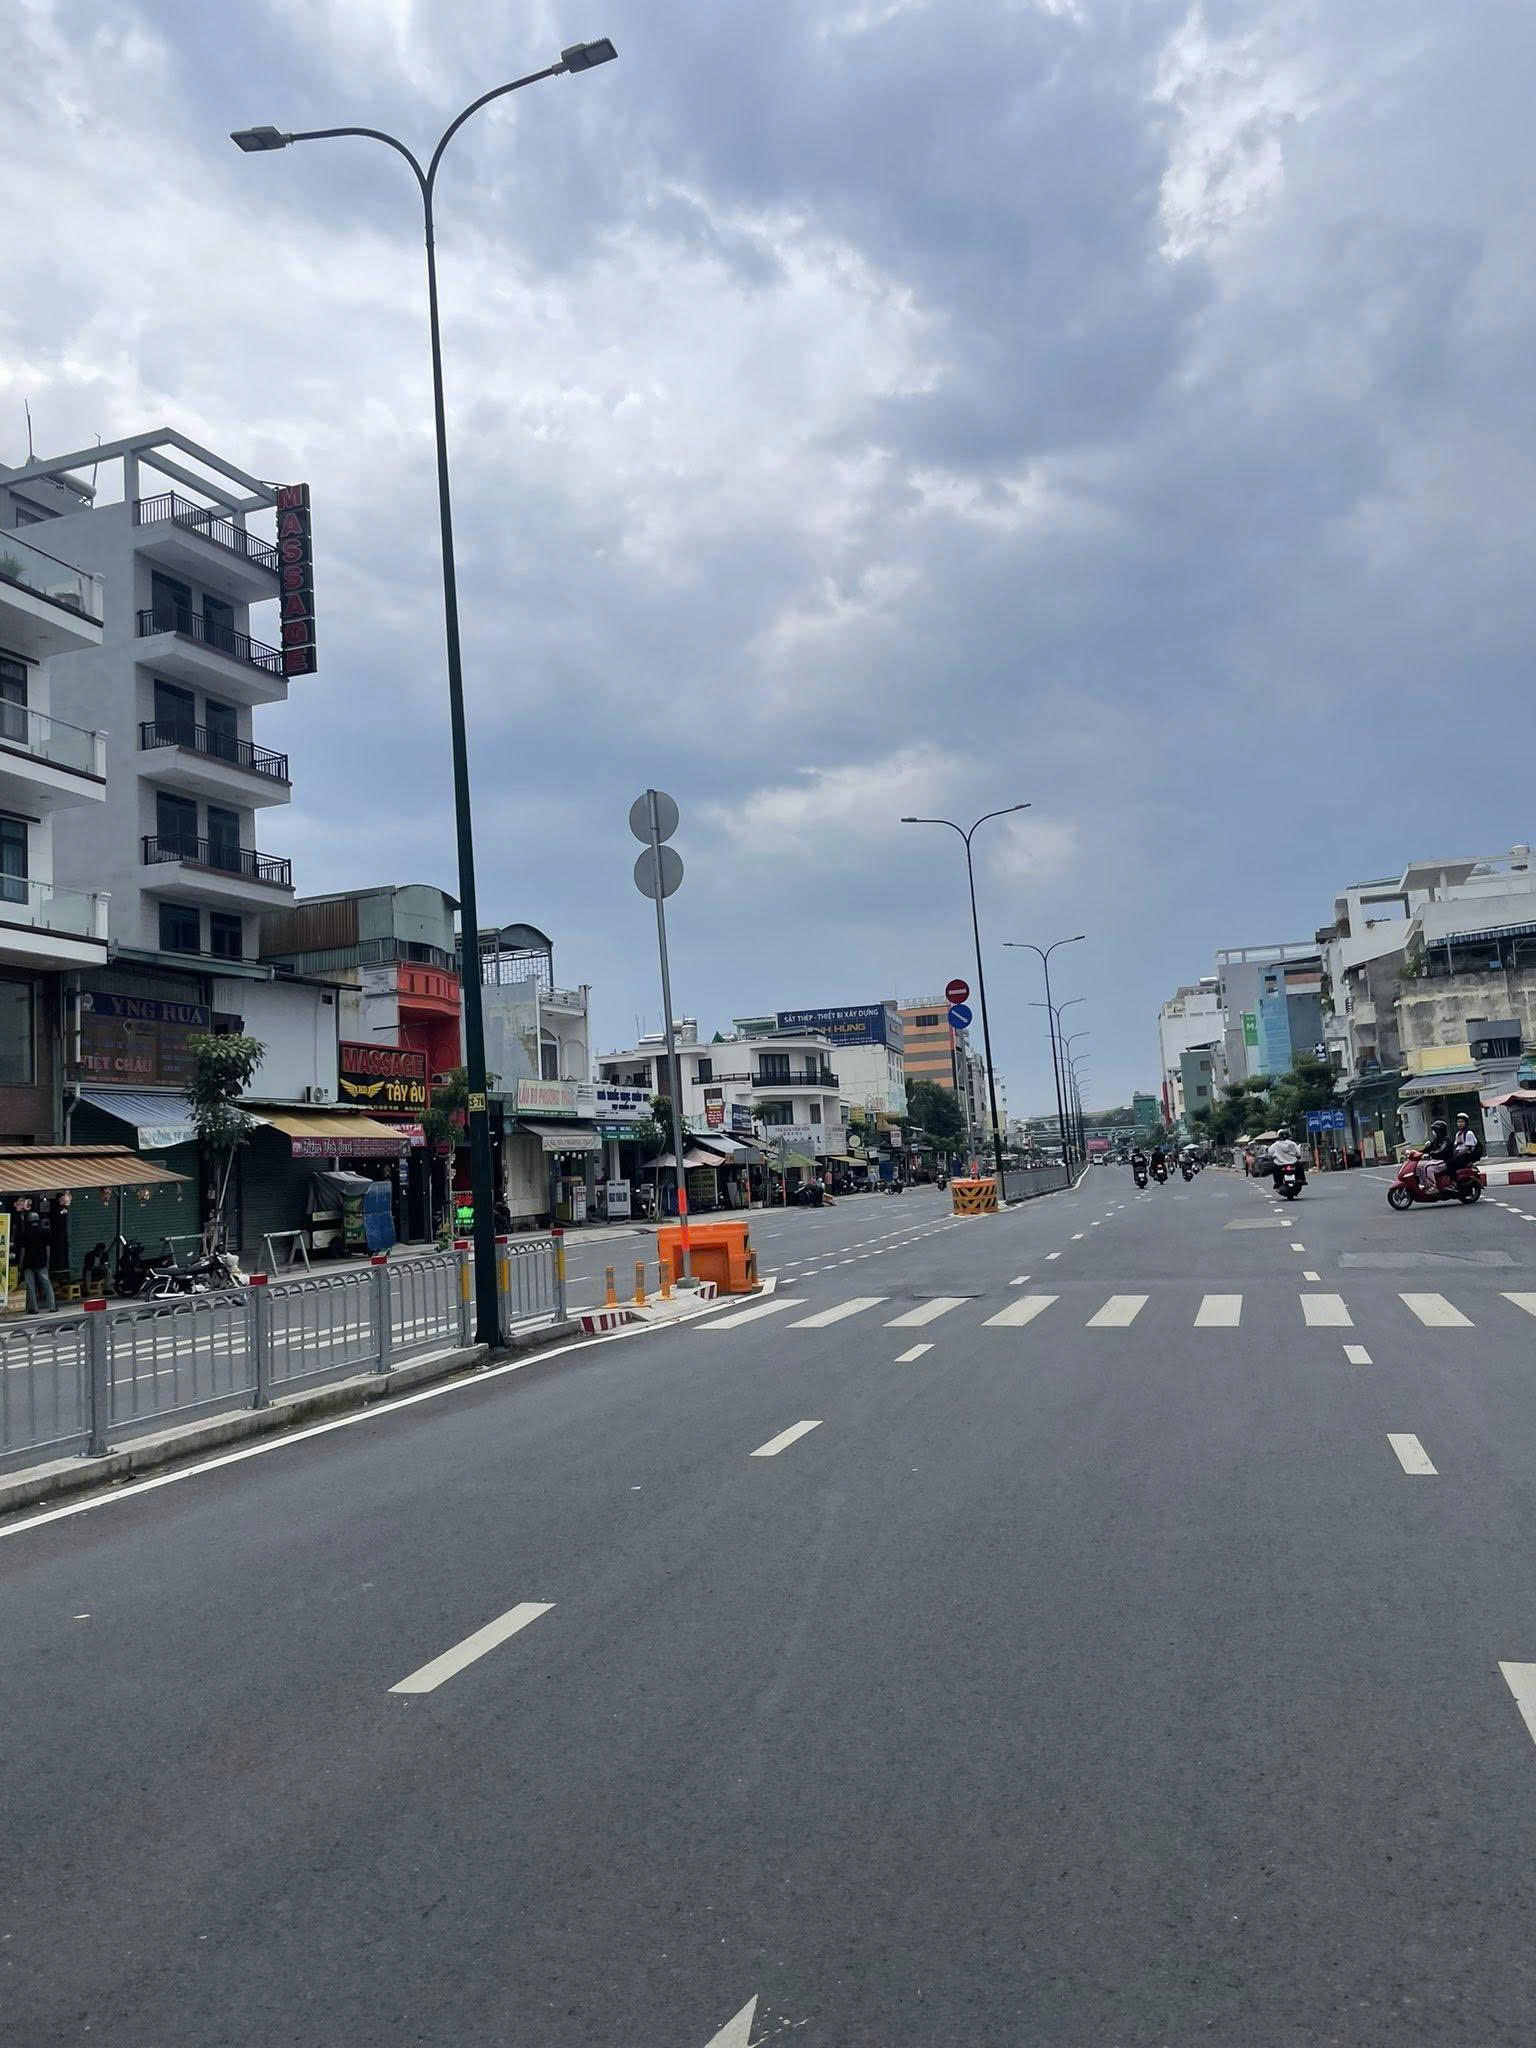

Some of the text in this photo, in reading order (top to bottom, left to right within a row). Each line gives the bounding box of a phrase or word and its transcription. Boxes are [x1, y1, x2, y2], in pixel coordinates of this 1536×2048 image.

[278, 486, 308, 671] MASSAGE
[343, 1047, 425, 1079] MASSAGE
[387, 1080, 426, 1103] TÂY ÂU
